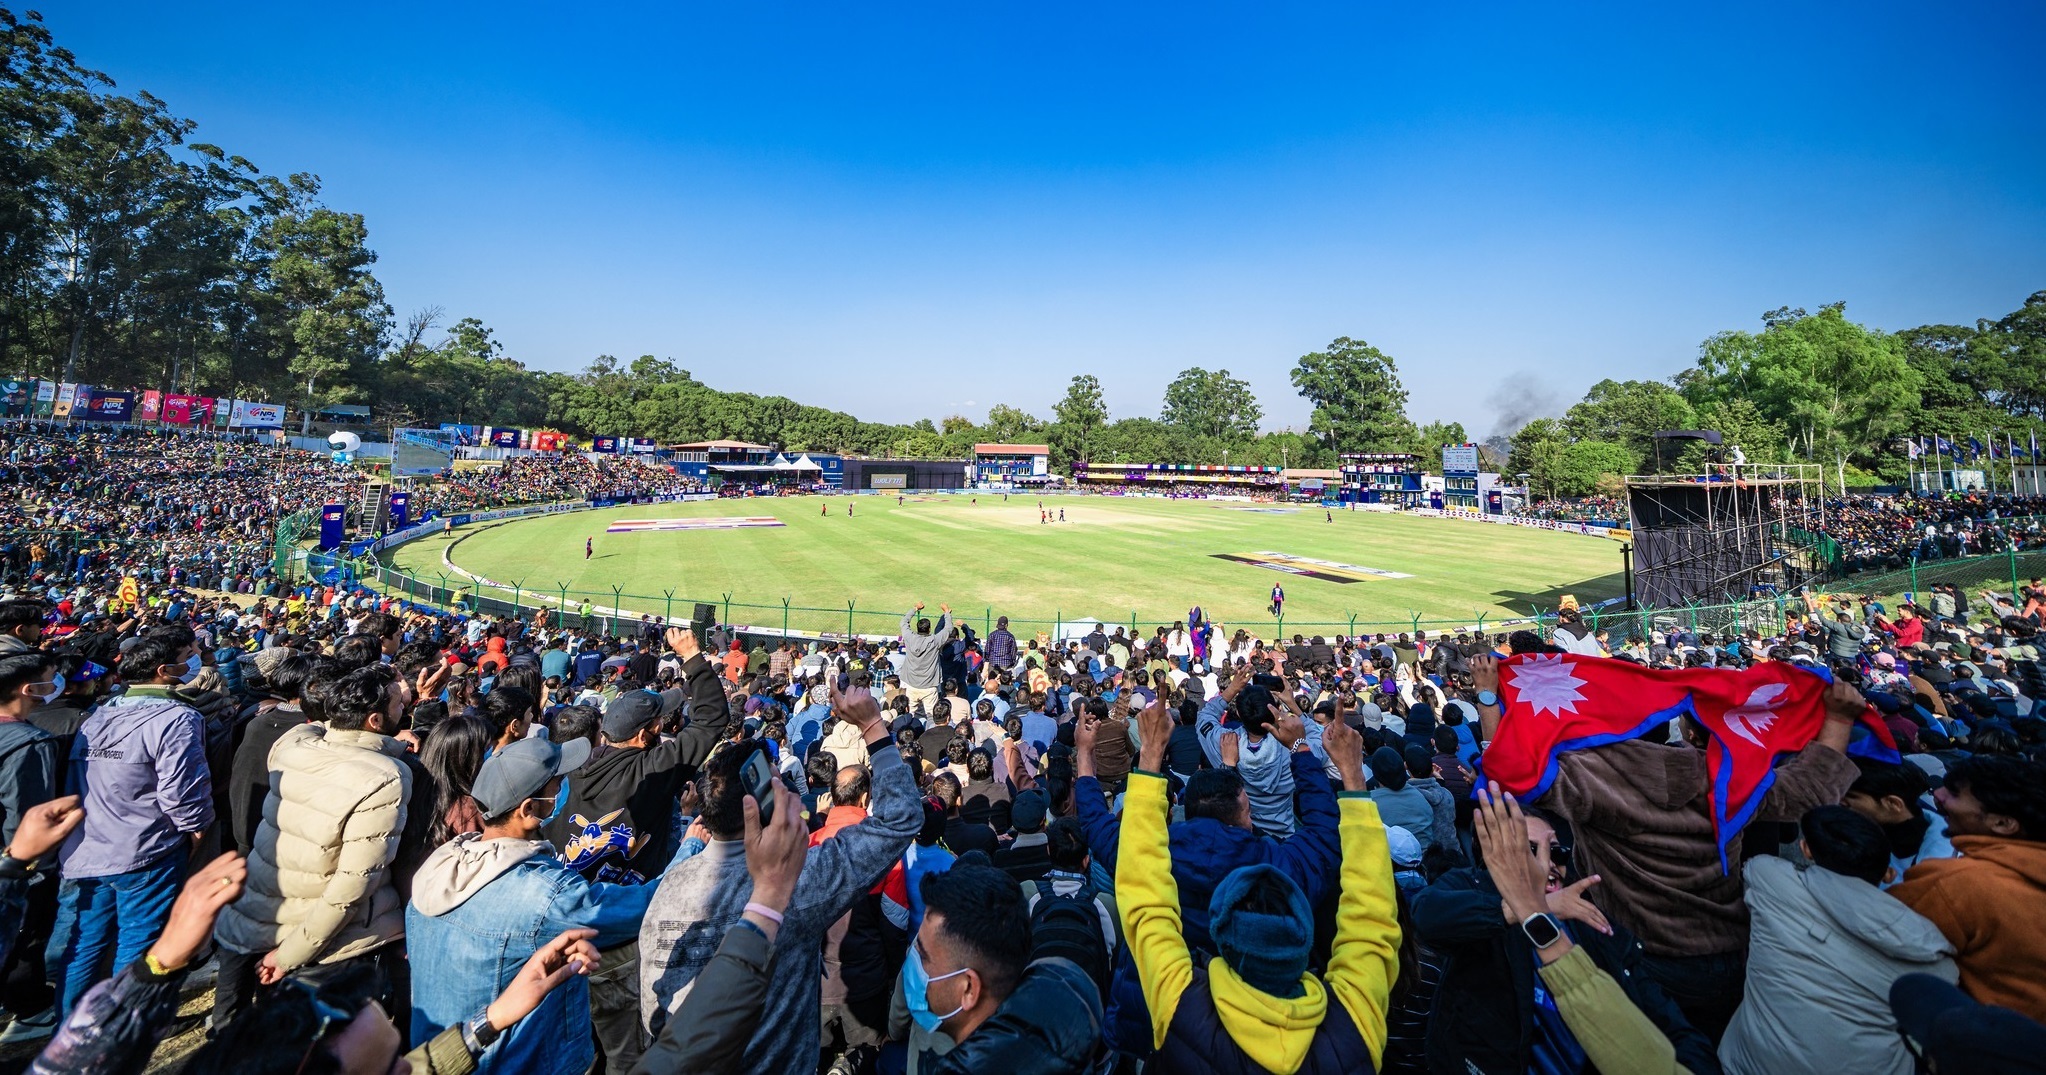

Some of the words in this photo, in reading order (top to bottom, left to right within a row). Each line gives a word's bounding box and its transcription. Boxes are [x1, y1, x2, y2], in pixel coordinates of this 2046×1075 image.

[102, 402, 124, 410] NPL
[122, 585, 136, 603] 6
[1032, 674, 1046, 692] 6
